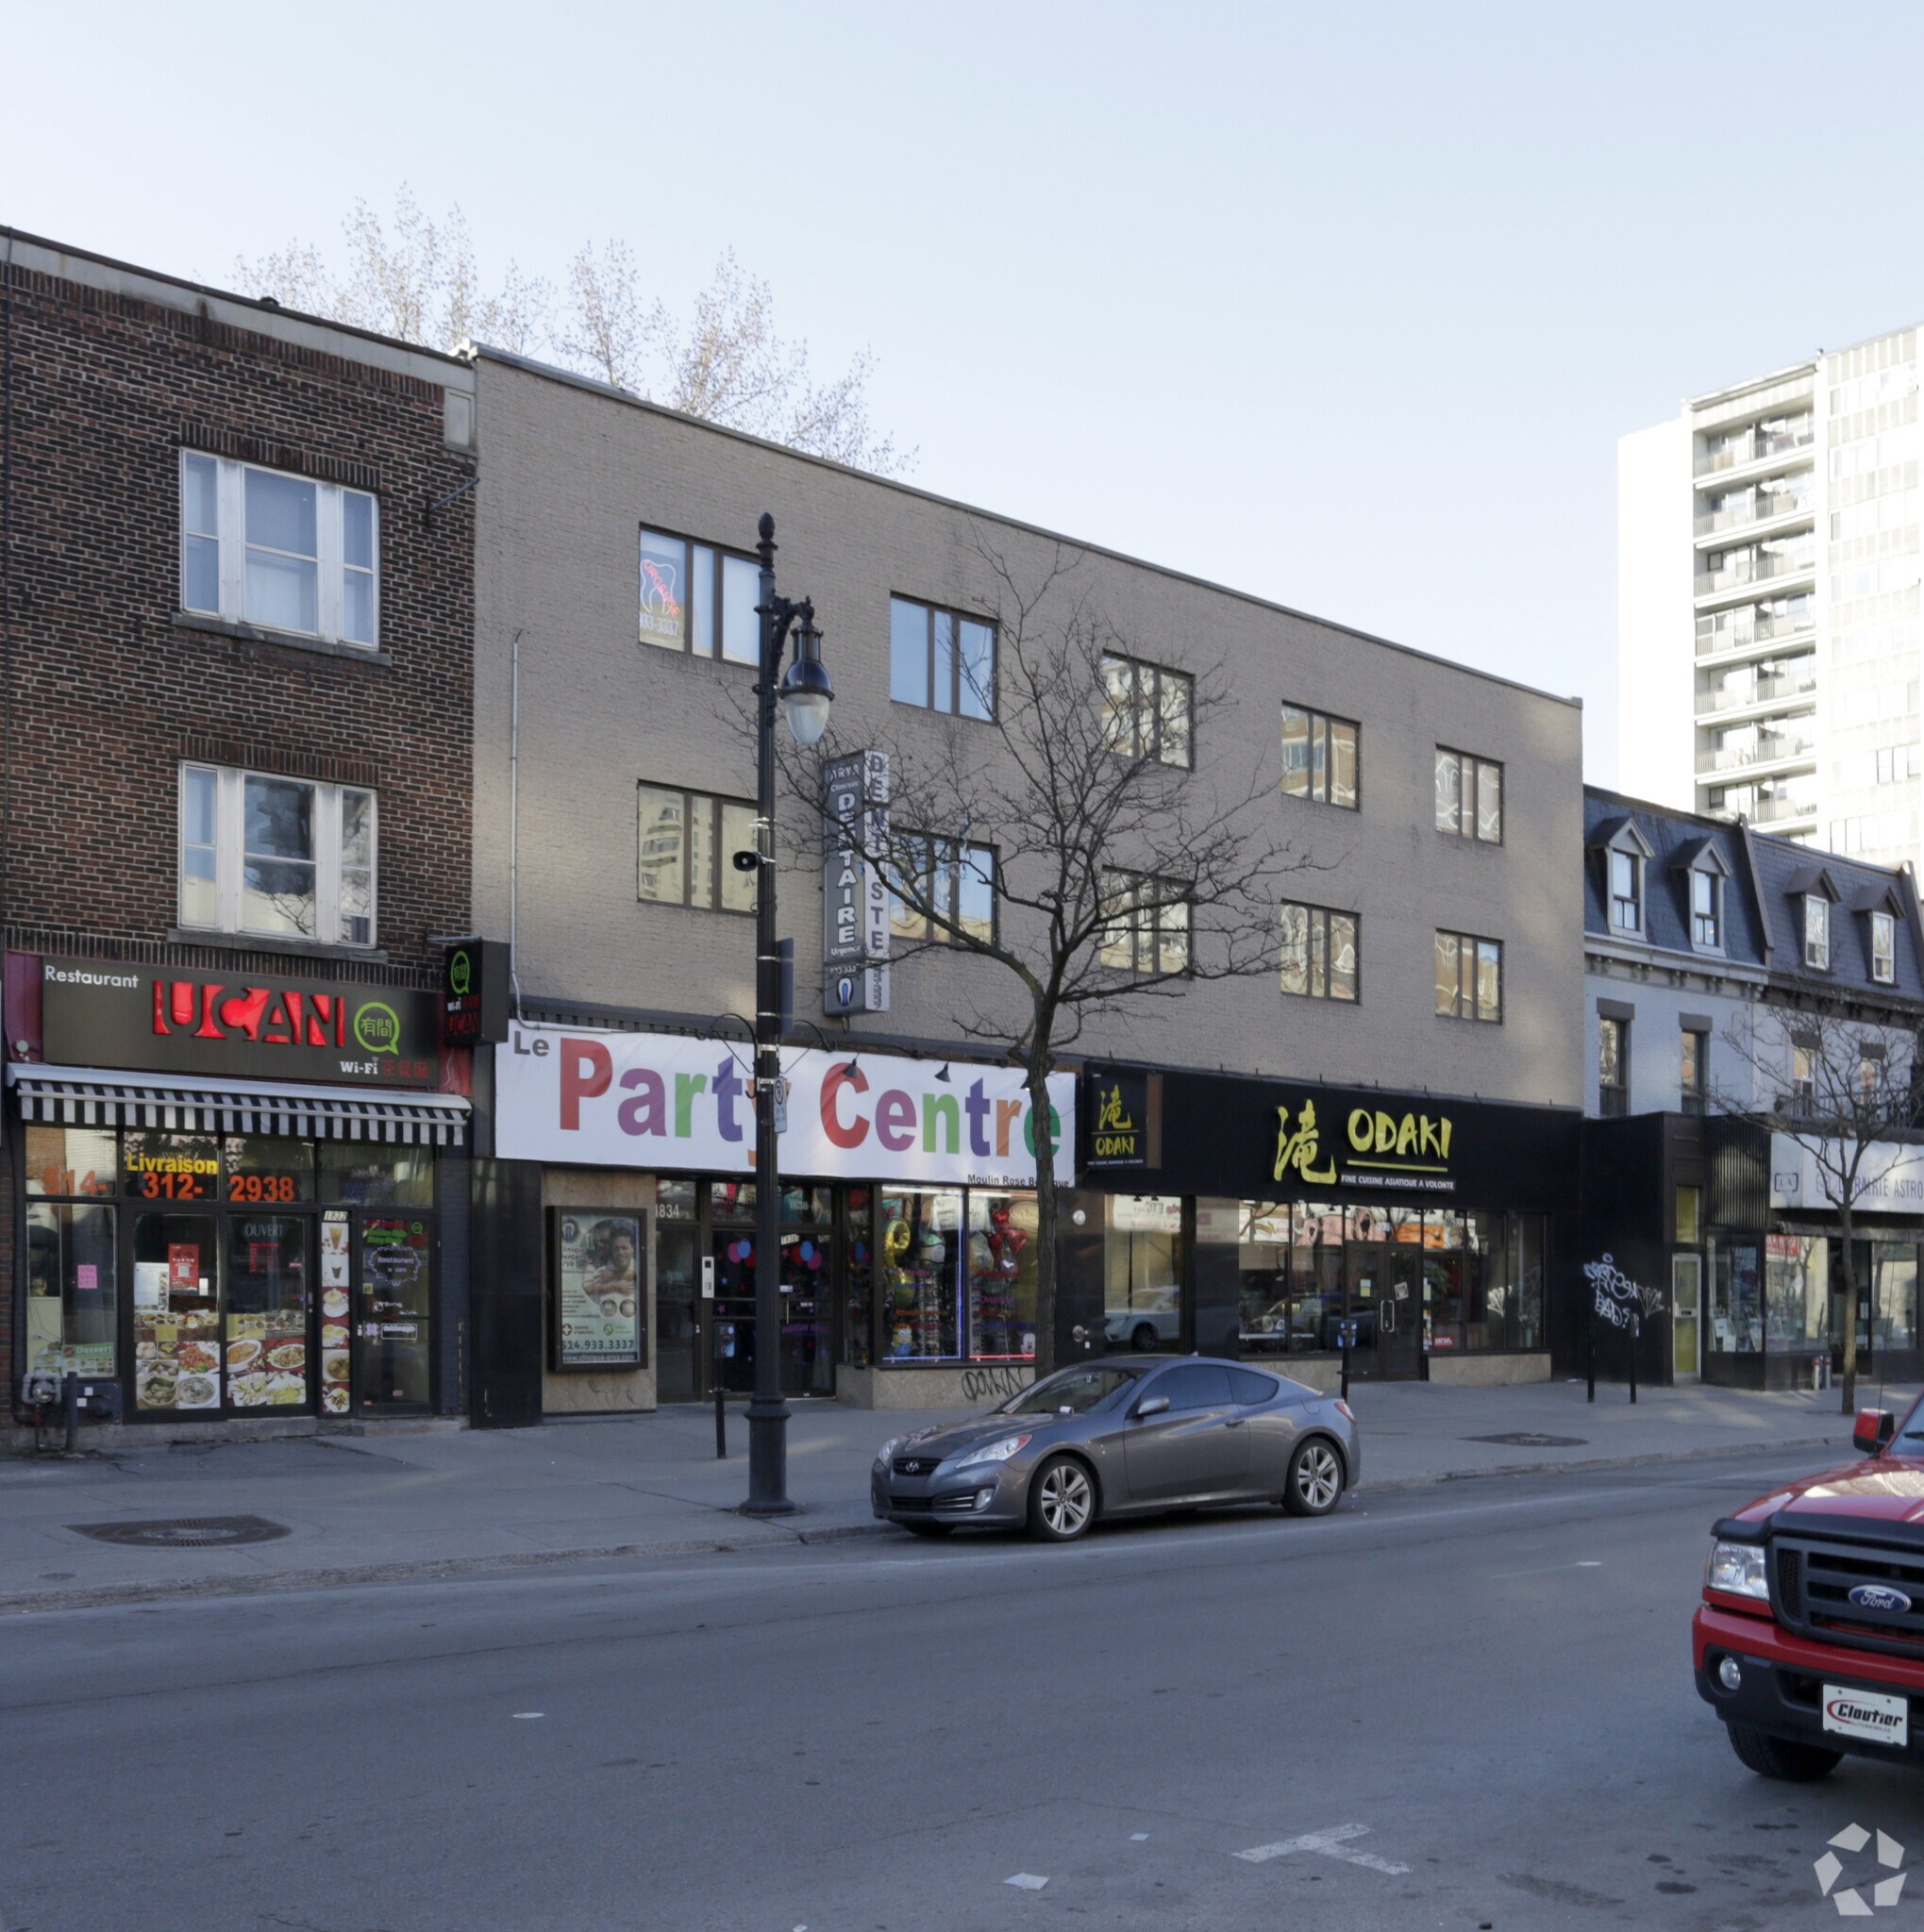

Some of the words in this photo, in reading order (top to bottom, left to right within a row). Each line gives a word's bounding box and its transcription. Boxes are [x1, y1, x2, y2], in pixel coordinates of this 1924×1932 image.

[44, 964, 139, 989] Restaurant
[153, 979, 345, 1047] UCAN
[360, 1017, 393, 1039] 有間
[513, 1028, 551, 1058] Le
[340, 1058, 378, 1075] Wi-Fi
[560, 1037, 791, 1167] Part
[1347, 1108, 1452, 1159] ODAKI
[1096, 1136, 1135, 1156] ODAKI
[125, 1152, 219, 1174] Livraison
[142, 1172, 204, 1199] 312-
[228, 1174, 295, 1202] 2938
[967, 1174, 999, 1186] Moulin
[1002, 1175, 1026, 1187] Rose
[1341, 1174, 1357, 1184] FINE
[1358, 1174, 1383, 1186] CUISINE
[1384, 1175, 1417, 1188] ASIATIQUE
[1425, 1178, 1455, 1191] VOLONTE
[1838, 1175, 1889, 1196] LBRAIRIE
[1894, 1179, 1924, 1200] ASTRO
[325, 1211, 348, 1221] 1832
[656, 1204, 679, 1219] 1834
[244, 1224, 284, 1238] OUVERT
[75, 1345, 112, 1354] Dessert
[1860, 1588, 1895, 1609] Ford
[1838, 1703, 1903, 1727] Cloutier
